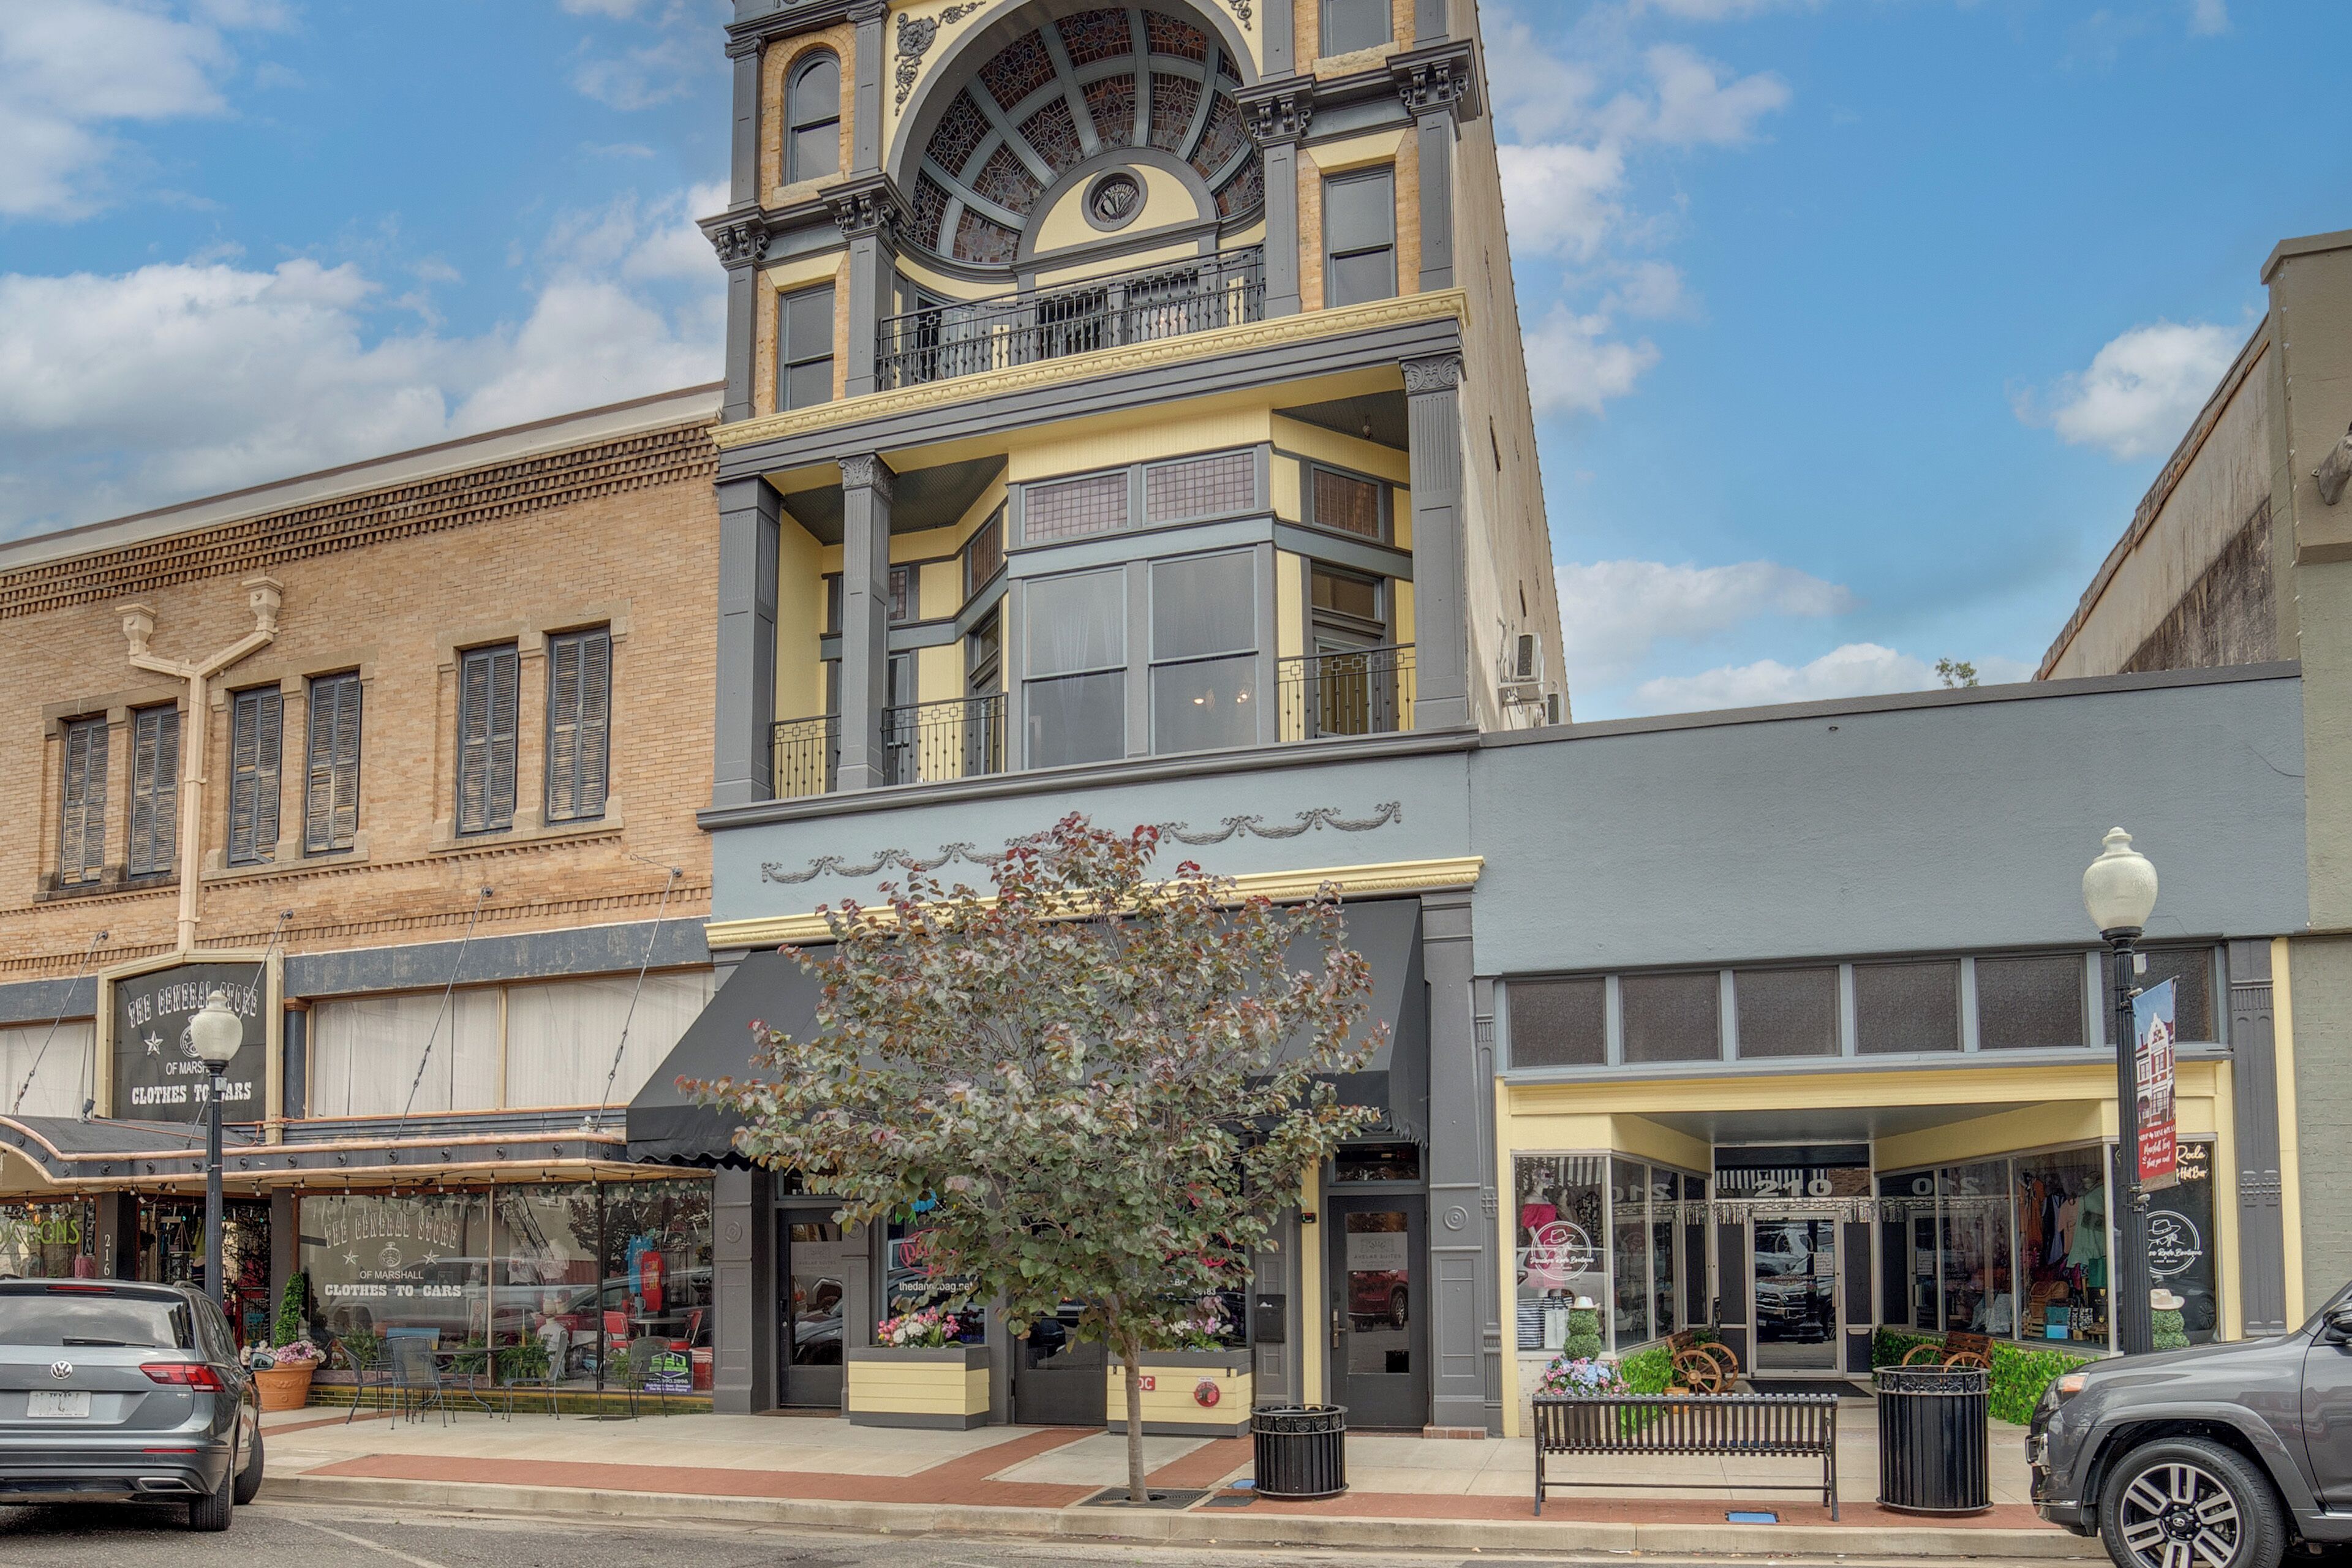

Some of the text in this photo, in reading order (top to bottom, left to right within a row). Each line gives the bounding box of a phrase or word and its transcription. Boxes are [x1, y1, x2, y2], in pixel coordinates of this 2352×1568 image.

[127, 993, 152, 1029] THE
[157, 981, 211, 1017] GENERAL
[165, 1060, 211, 1076] OF MARSH
[132, 1081, 252, 1106] CLOTHES TO ARS
[1754, 1178, 1833, 1197] 210
[0, 1218, 80, 1246] ICTIONS
[324, 1210, 459, 1250] THE GENERAL STORE
[359, 1270, 424, 1280] OF MARSHALL
[325, 1284, 462, 1297] CLOTHES TO CARS
